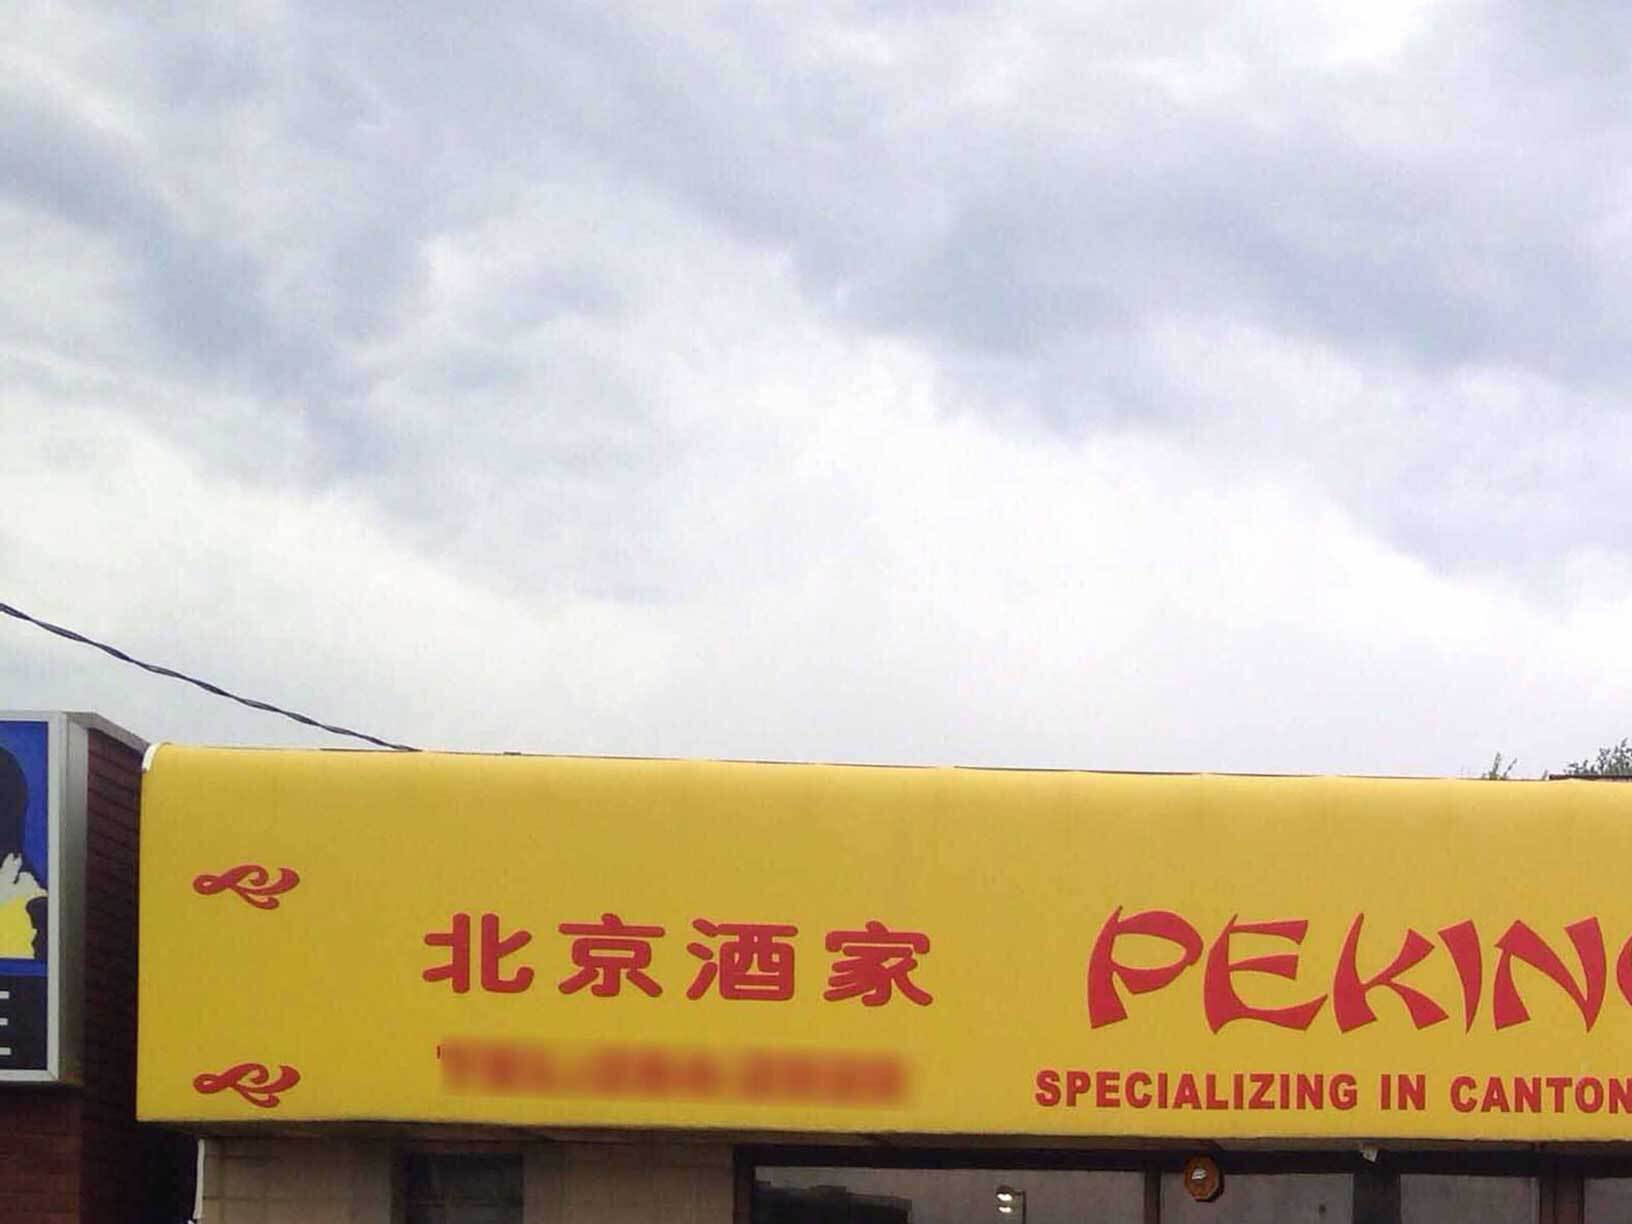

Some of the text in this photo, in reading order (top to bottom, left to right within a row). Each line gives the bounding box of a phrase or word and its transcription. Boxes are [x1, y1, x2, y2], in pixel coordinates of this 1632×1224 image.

[422, 911, 934, 1007] 北京酒家
[1033, 1067, 1358, 1112] SPECIALIZING
[1379, 1072, 1427, 1112] IN
